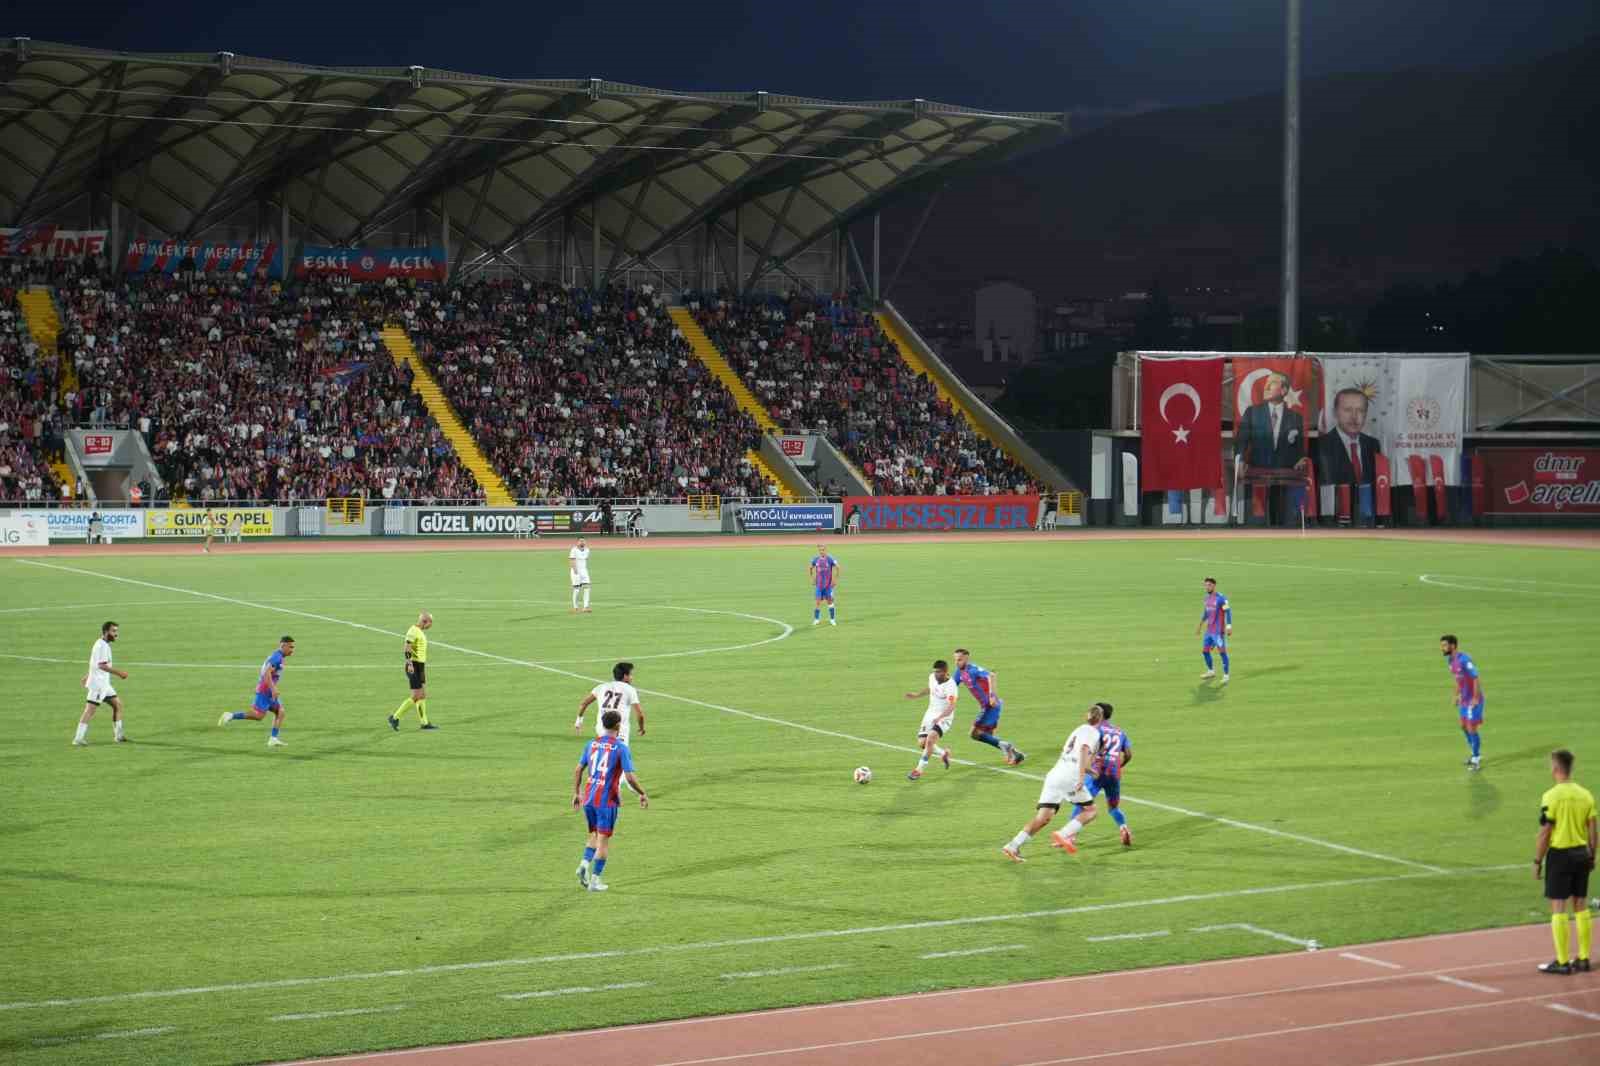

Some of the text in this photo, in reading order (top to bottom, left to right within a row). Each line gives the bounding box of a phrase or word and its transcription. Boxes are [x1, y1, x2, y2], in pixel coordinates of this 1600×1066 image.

[303, 252, 434, 273] ESKİ AÇIK
[420, 512, 470, 532] GÜZEL
[602, 690, 623, 709] 27
[1102, 733, 1120, 757] 22
[589, 751, 609, 777] 14
